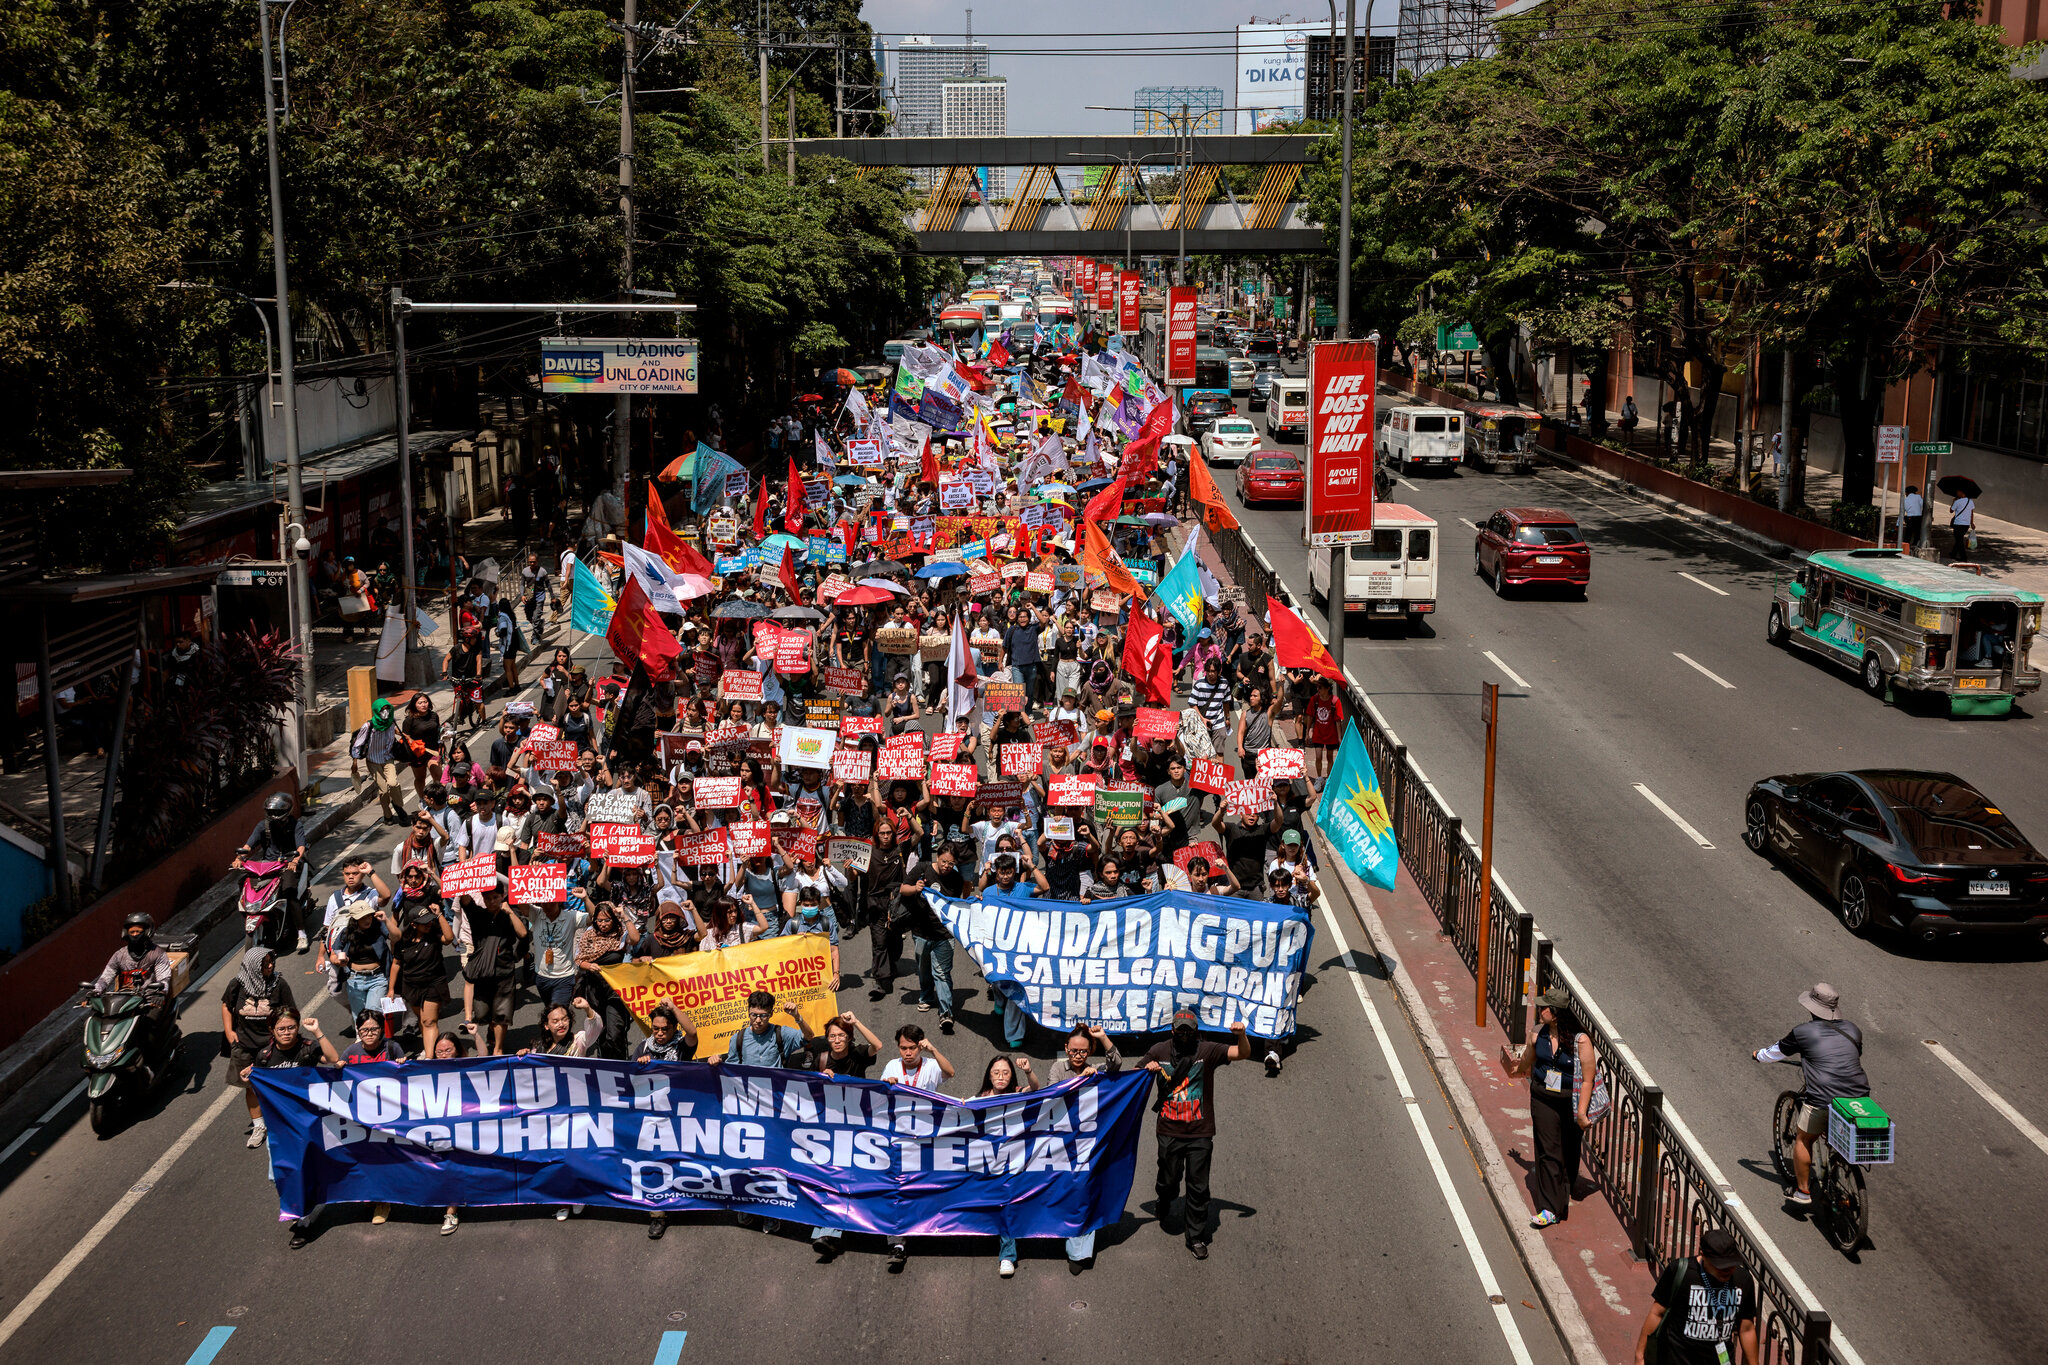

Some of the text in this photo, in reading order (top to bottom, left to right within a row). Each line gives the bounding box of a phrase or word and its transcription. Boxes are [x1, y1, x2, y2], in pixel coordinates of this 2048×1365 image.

[1269, 67, 1291, 81] KA
[1137, 111, 1220, 135] JESUS
[1174, 302, 1194, 311] KEEP
[616, 344, 685, 358] LOADING
[544, 358, 601, 371] DAVIES
[606, 368, 695, 381] UNLOADING
[1325, 375, 1365, 394] LIFE
[1319, 394, 1369, 415] DOES
[1324, 414, 1363, 433] NOT
[1319, 433, 1367, 454] WAIT
[1328, 468, 1358, 477] MOVE
[862, 722, 880, 731] VAT
[705, 728, 737, 742] SCRAP
[886, 733, 923, 748] PRESYO NG
[533, 741, 576, 752] PRESYO NG
[1001, 743, 1042, 754] EXCISE TAX
[847, 749, 860, 759] VAT
[878, 748, 922, 758] YOUTH FIGHT
[1001, 753, 1042, 764] SA LANGIS
[559, 760, 577, 770] BACK
[879, 758, 924, 767] BACK AGAINST
[1004, 763, 1037, 773] ALISIN!
[1195, 759, 1224, 776] NO TO
[889, 768, 906, 777] PRICE
[907, 768, 921, 777] HIKE
[937, 764, 972, 775] PRESYO NG
[931, 780, 976, 790] I-ROLL BACK!
[1208, 775, 1227, 789] VAT!
[1095, 800, 1141, 808] DEREGULATION
[1226, 804, 1246, 817] SA
[592, 825, 607, 837] OIL
[755, 822, 767, 830] NG
[682, 830, 719, 848] IPRENO
[1331, 798, 1384, 869] KABATAAN
[608, 836, 617, 845] US
[751, 838, 767, 847] ANG
[679, 842, 725, 857] ang taas
[793, 840, 816, 855] BACK!
[832, 842, 870, 854] Ligwakin
[842, 848, 857, 857] ang
[687, 854, 723, 865] PRESYO
[852, 854, 868, 866] VAT
[464, 869, 474, 878] SA
[473, 866, 496, 877] TUBO?
[510, 867, 531, 878] 12%
[442, 881, 459, 893] BABY
[511, 878, 568, 892] SA BILIHIN
[1970, 881, 1986, 892] NEK
[1157, 906, 1308, 968] NG PUP
[652, 955, 826, 1001] COMMUNITY JOINS
[1013, 954, 1054, 985] SA
[1058, 957, 1178, 987] WELGA
[1181, 961, 1284, 1008] LABAN
[672, 971, 823, 1011] EOPLE'S STRIKE!
[807, 992, 828, 1002] EXCISE
[694, 1002, 733, 1016] KOMYUTER
[787, 987, 820, 998] MAGKAISA!
[695, 1020, 710, 1029] ANG
[308, 1066, 1099, 1137] KOMYUTER, MAKIBAKA!
[637, 1116, 765, 1160] ANG
[790, 1127, 1097, 1174] SISTEMA!
[622, 1158, 798, 1202] para
[731, 1193, 796, 1209] NETWORK
[1688, 1287, 1742, 1307] IKULONG
